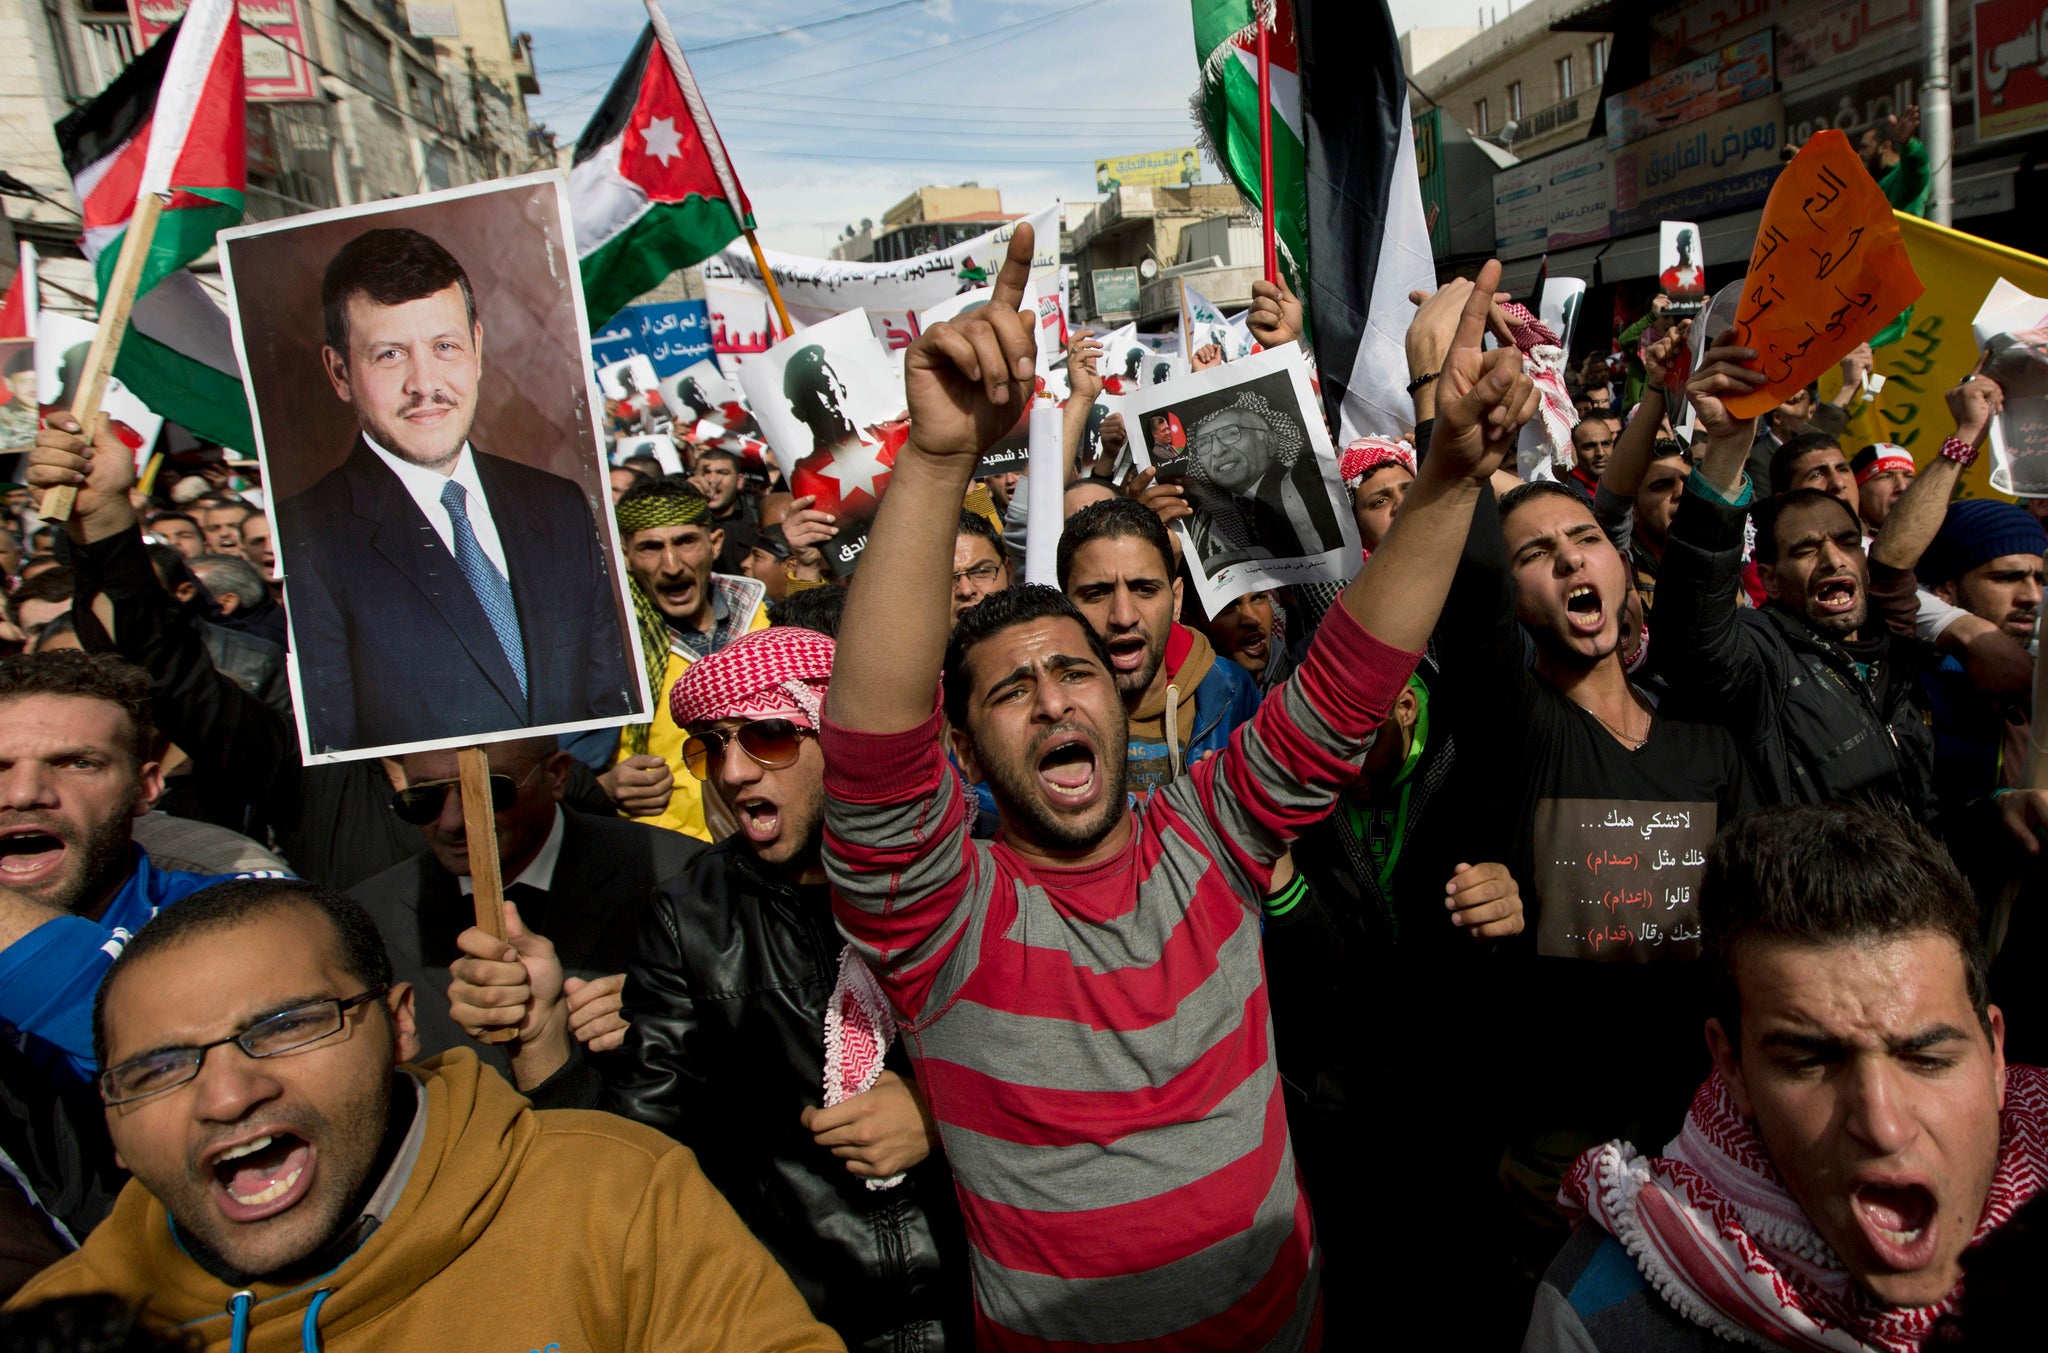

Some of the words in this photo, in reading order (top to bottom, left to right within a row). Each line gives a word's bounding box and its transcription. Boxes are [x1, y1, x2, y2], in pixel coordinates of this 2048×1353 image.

[1534, 110, 1556, 135] ARAB
[1712, 122, 1776, 168] معرض
[1645, 132, 1708, 188] الفاروق
[1550, 208, 1574, 225] عثمان
[1575, 200, 1607, 217] معرض
[1809, 226, 1864, 280] خط
[982, 448, 1015, 466] شهيد
[838, 534, 868, 562] الحق
[1586, 850, 1639, 876] (صدام)
[1651, 849, 1676, 871] مثل
[1664, 885, 1690, 911] قالوا
[1637, 922, 1664, 946] وقال
